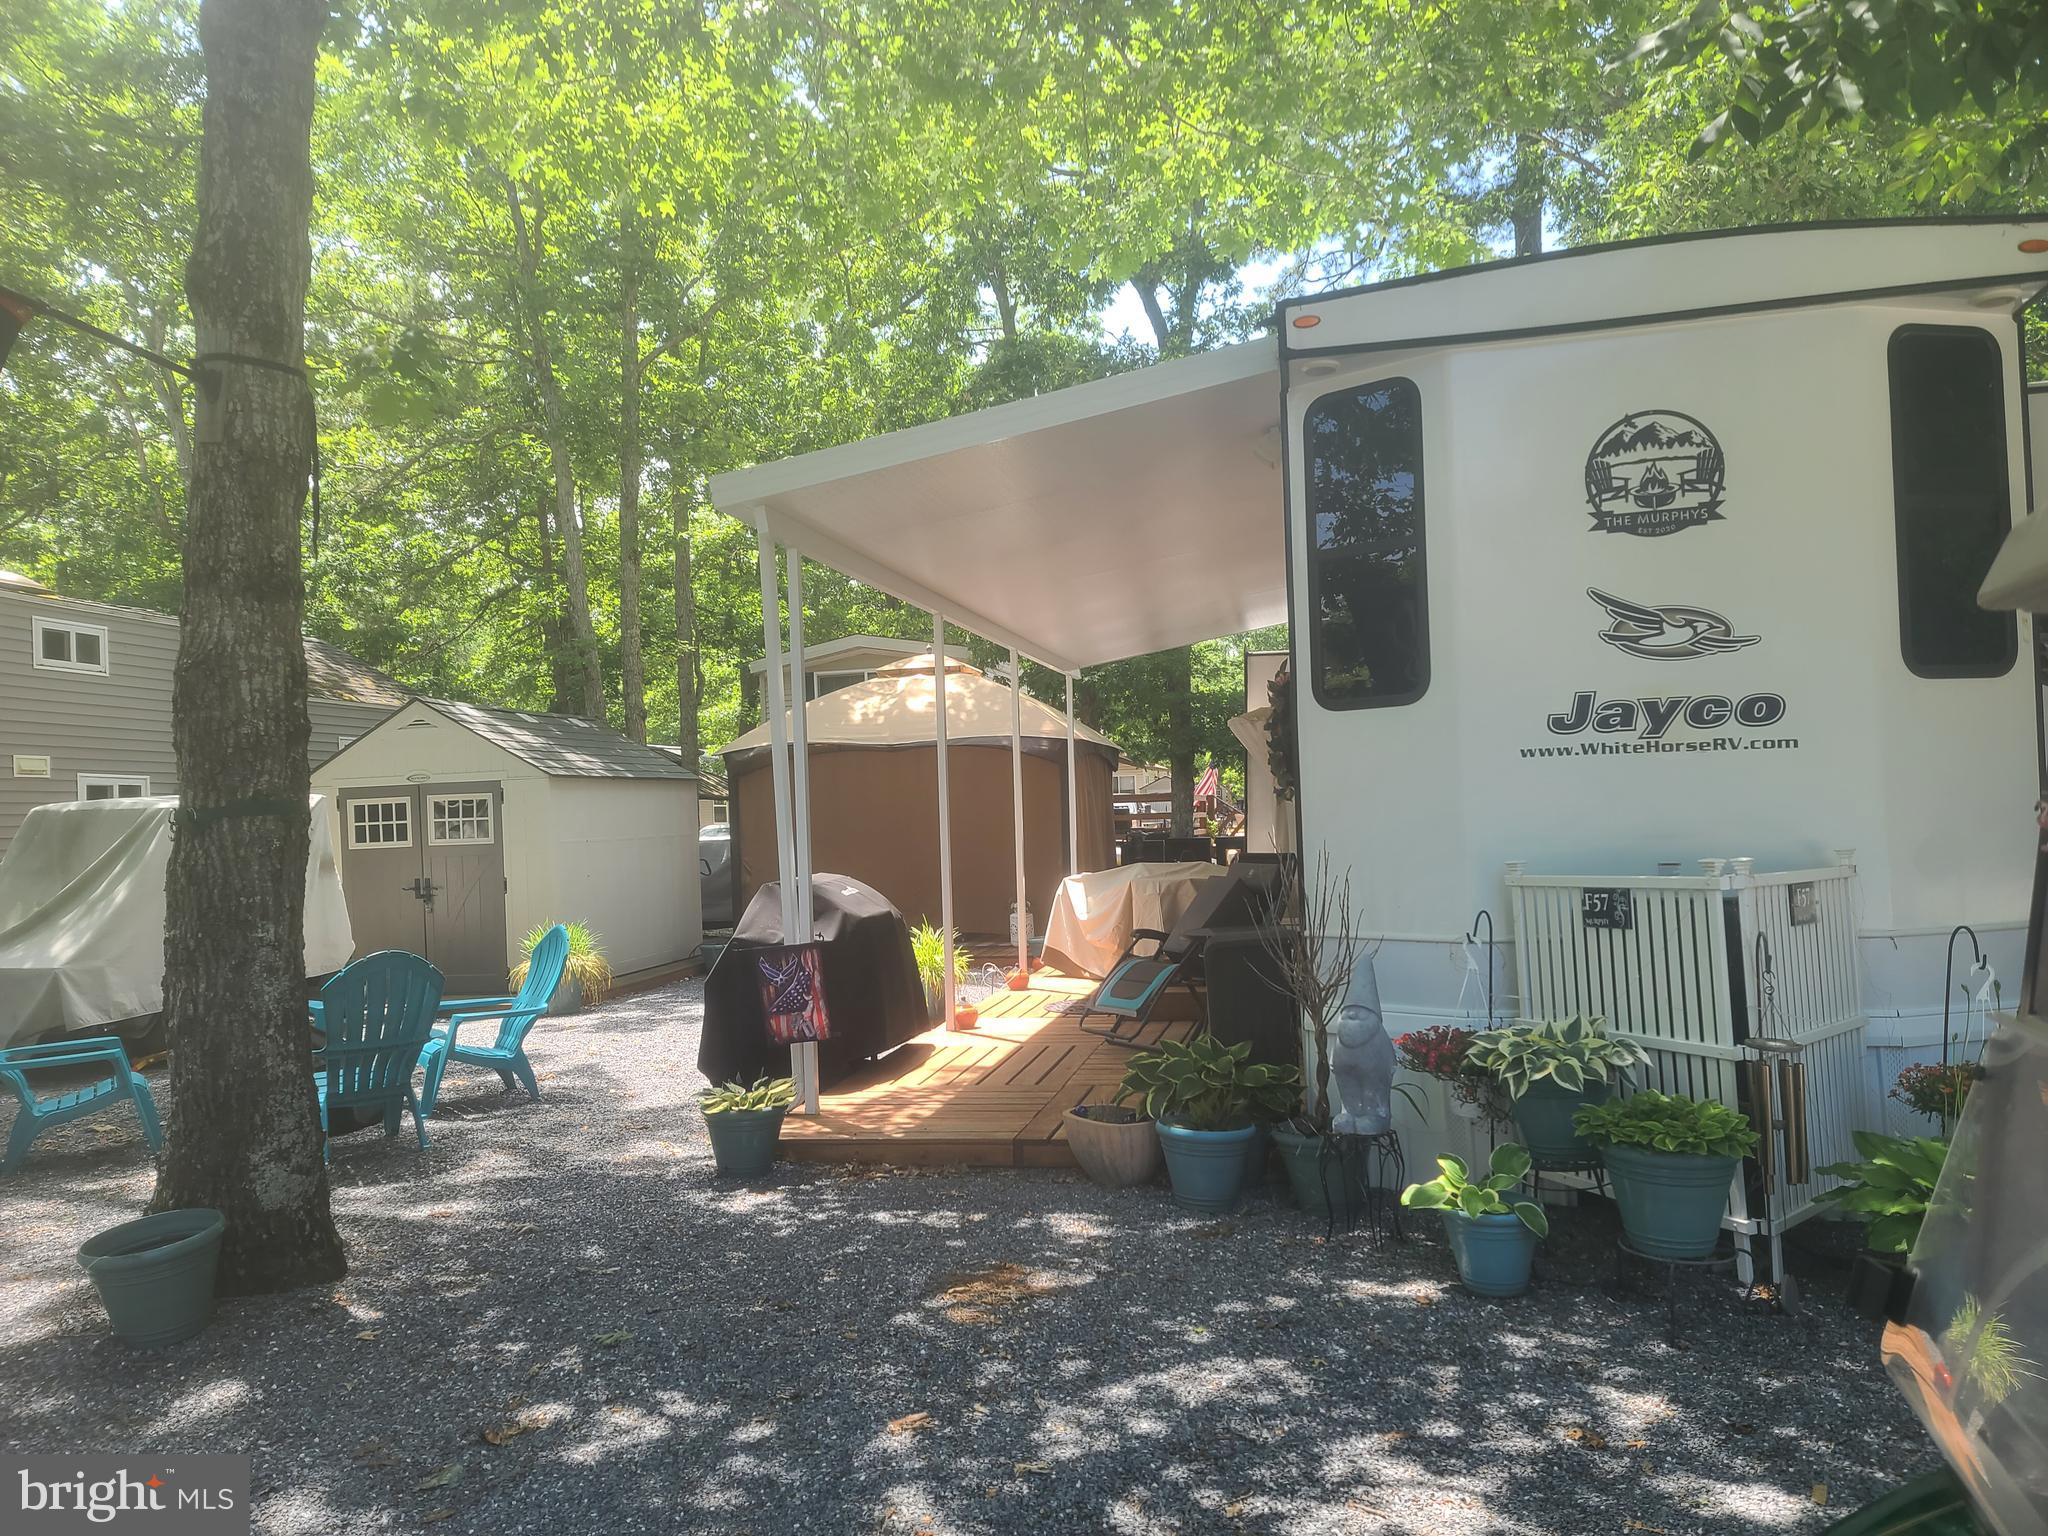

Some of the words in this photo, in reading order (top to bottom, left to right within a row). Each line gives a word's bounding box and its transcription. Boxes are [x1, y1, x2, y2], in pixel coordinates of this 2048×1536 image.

[1604, 515, 1632, 528] THE
[1637, 508, 1708, 525] MURPHYS
[1547, 690, 1786, 739] Jayco
[1520, 736, 1799, 758] www.WhiteHorseRV.com
[1584, 893, 1609, 911] F57
